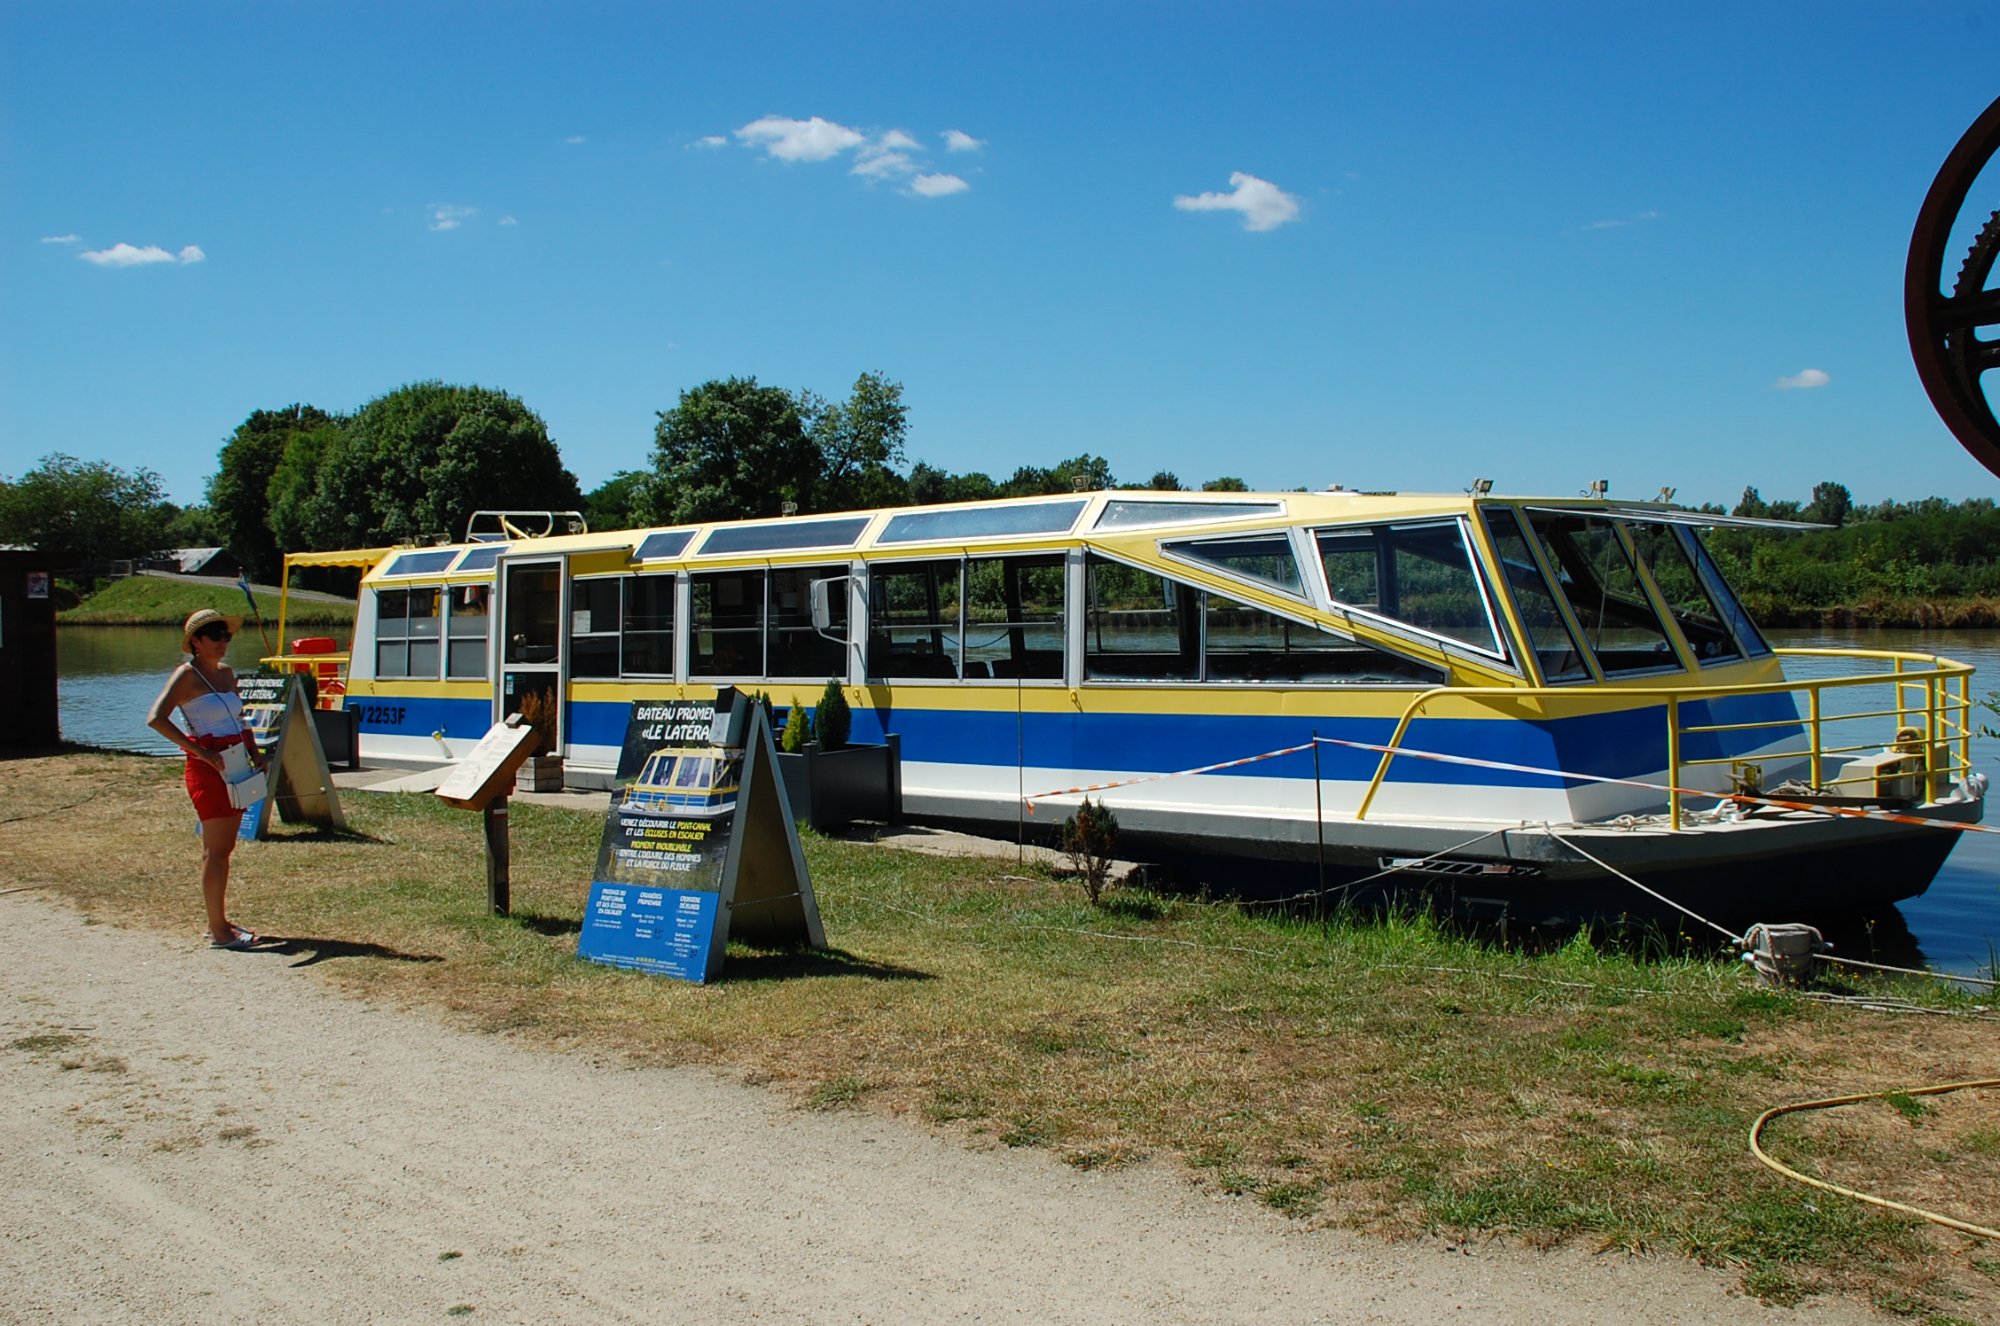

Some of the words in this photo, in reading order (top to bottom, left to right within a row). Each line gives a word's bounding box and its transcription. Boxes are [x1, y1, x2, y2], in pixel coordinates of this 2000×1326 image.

[637, 707, 676, 720] BATEAU
[676, 707, 715, 720] PROMEN
[664, 721, 710, 740] LATÉRA
[621, 818, 639, 827] VENEZ
[638, 818, 669, 828] DÉCOUVRIR
[669, 821, 677, 829] LE
[626, 828, 634, 836] ET
[644, 827, 668, 838] ÉCLUSES
[677, 831, 704, 840] ESCALIER
[631, 841, 655, 849] MOMENT
[656, 843, 692, 852] INOUBLIABLE
